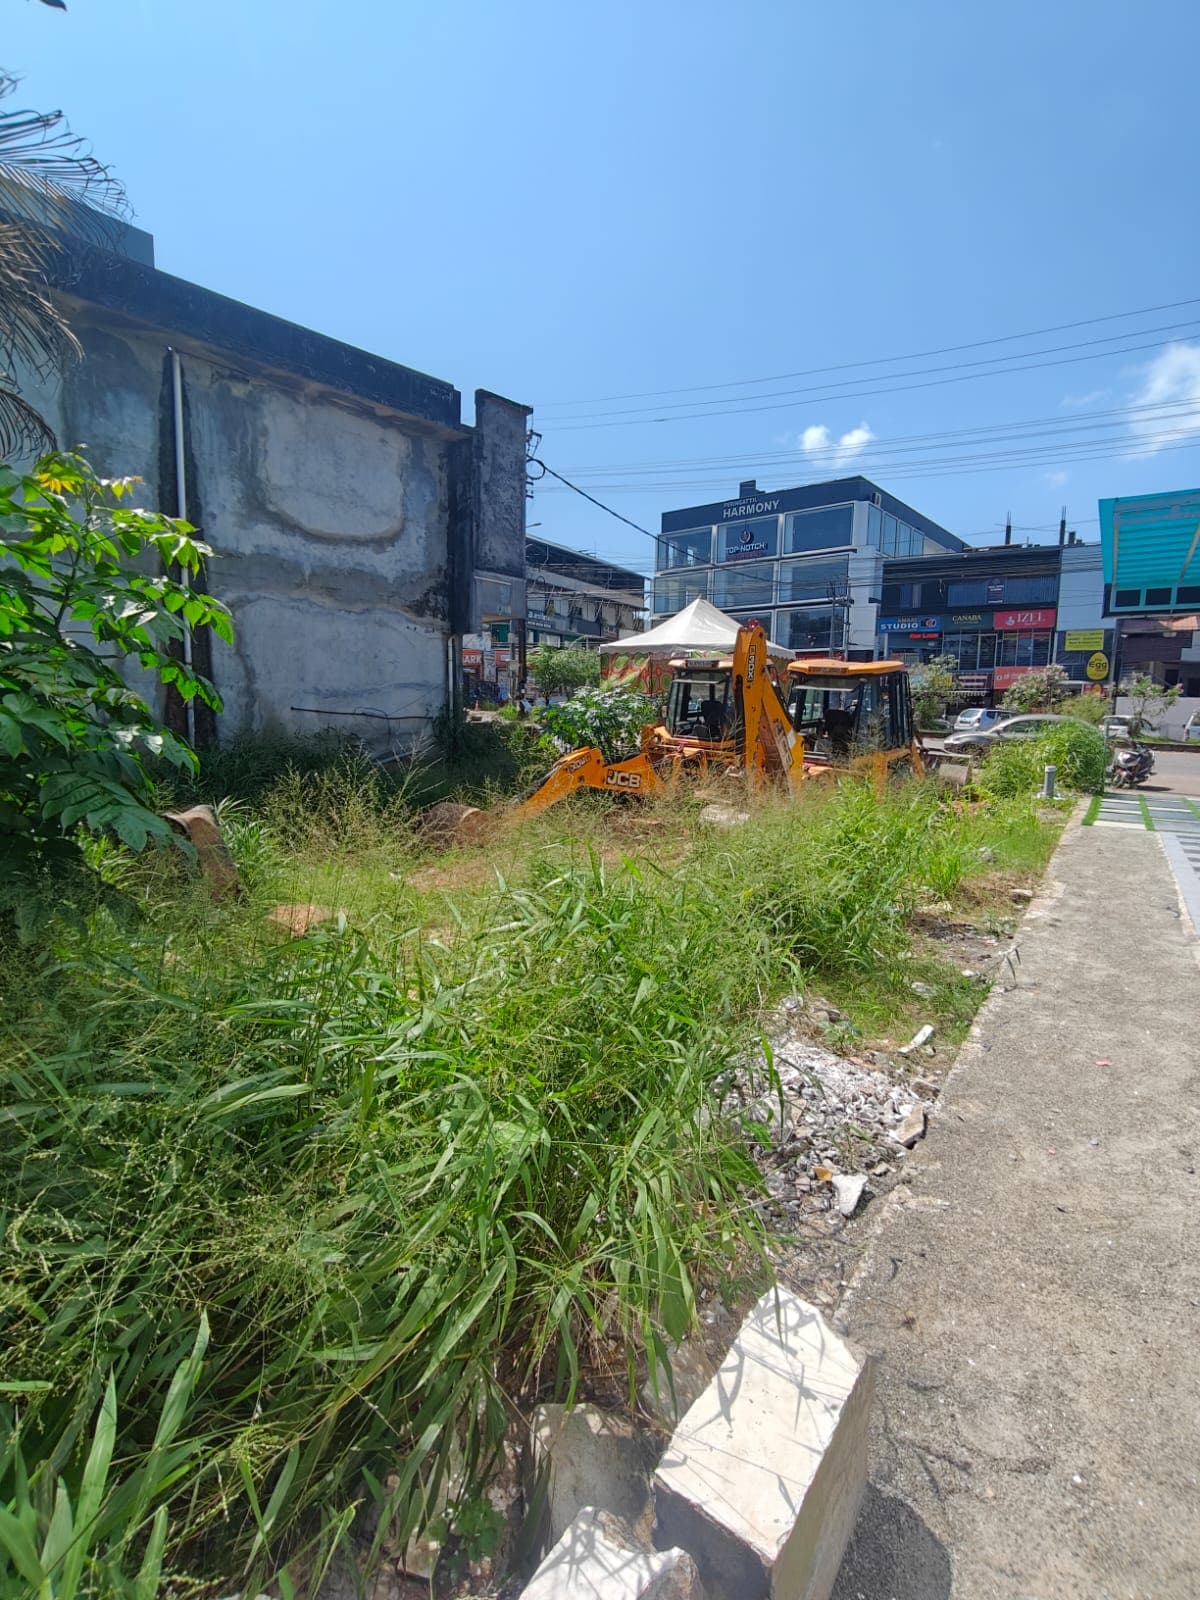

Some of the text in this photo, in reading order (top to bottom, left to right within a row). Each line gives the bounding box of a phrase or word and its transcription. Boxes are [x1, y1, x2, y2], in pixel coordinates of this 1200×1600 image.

[723, 499, 780, 519] HARMONY
[880, 622, 919, 630] STUDIO
[1089, 661, 1107, 670] Egg
[607, 770, 641, 788] JCB
